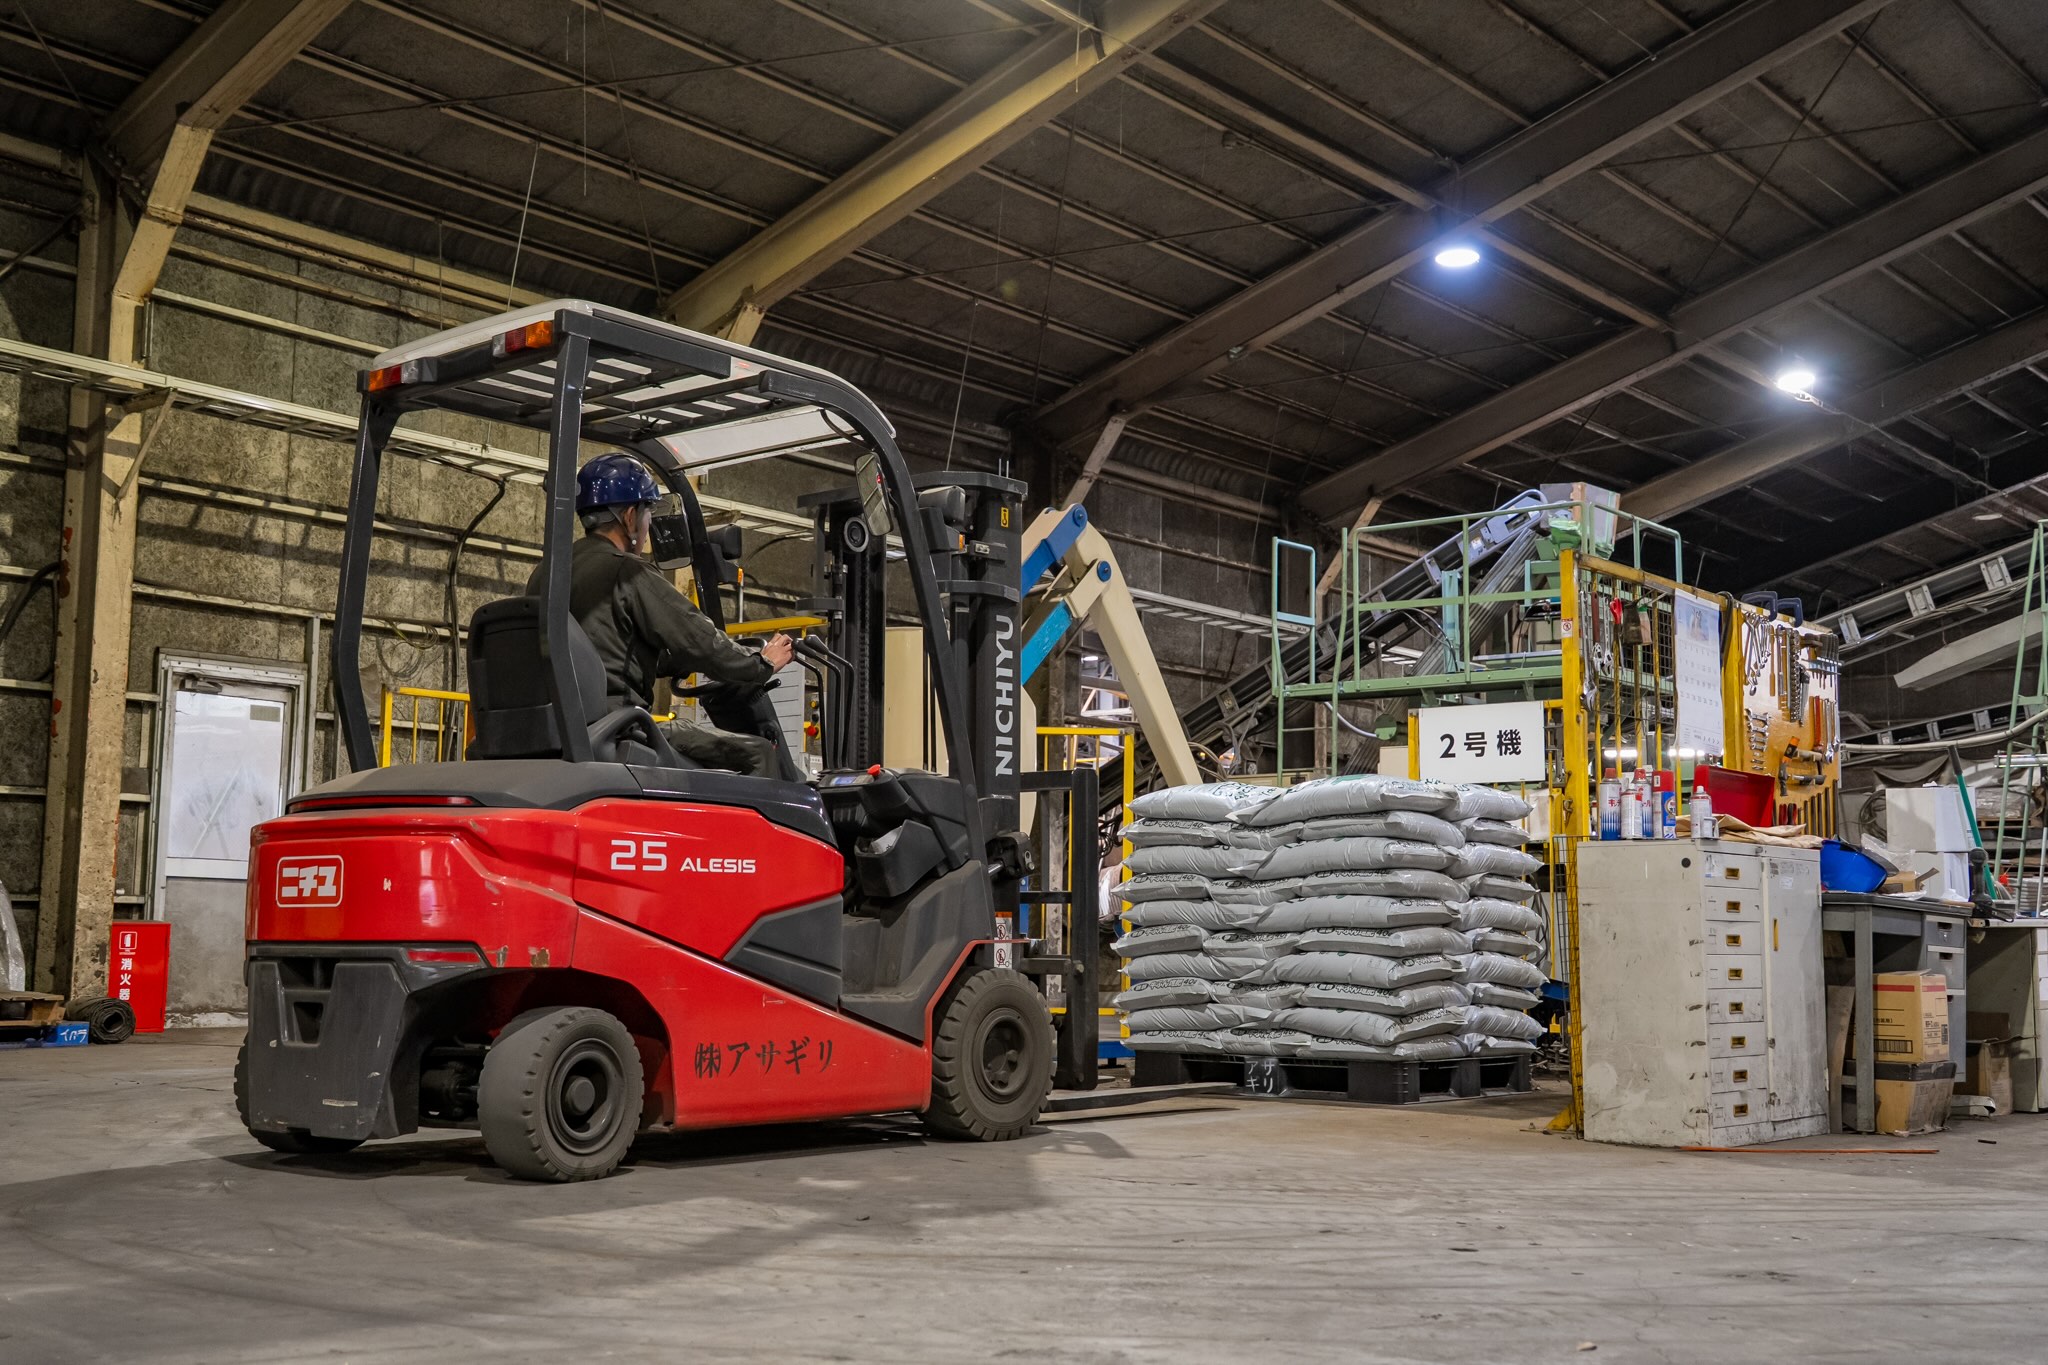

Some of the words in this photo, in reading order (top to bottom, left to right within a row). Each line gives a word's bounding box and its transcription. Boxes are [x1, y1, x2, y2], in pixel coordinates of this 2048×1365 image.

[995, 614, 1014, 777] NICHIYU
[1440, 729, 1522, 759] 2号機
[610, 840, 668, 871] 25
[680, 857, 757, 874] ALESIS
[119, 958, 133, 1001] 消火器
